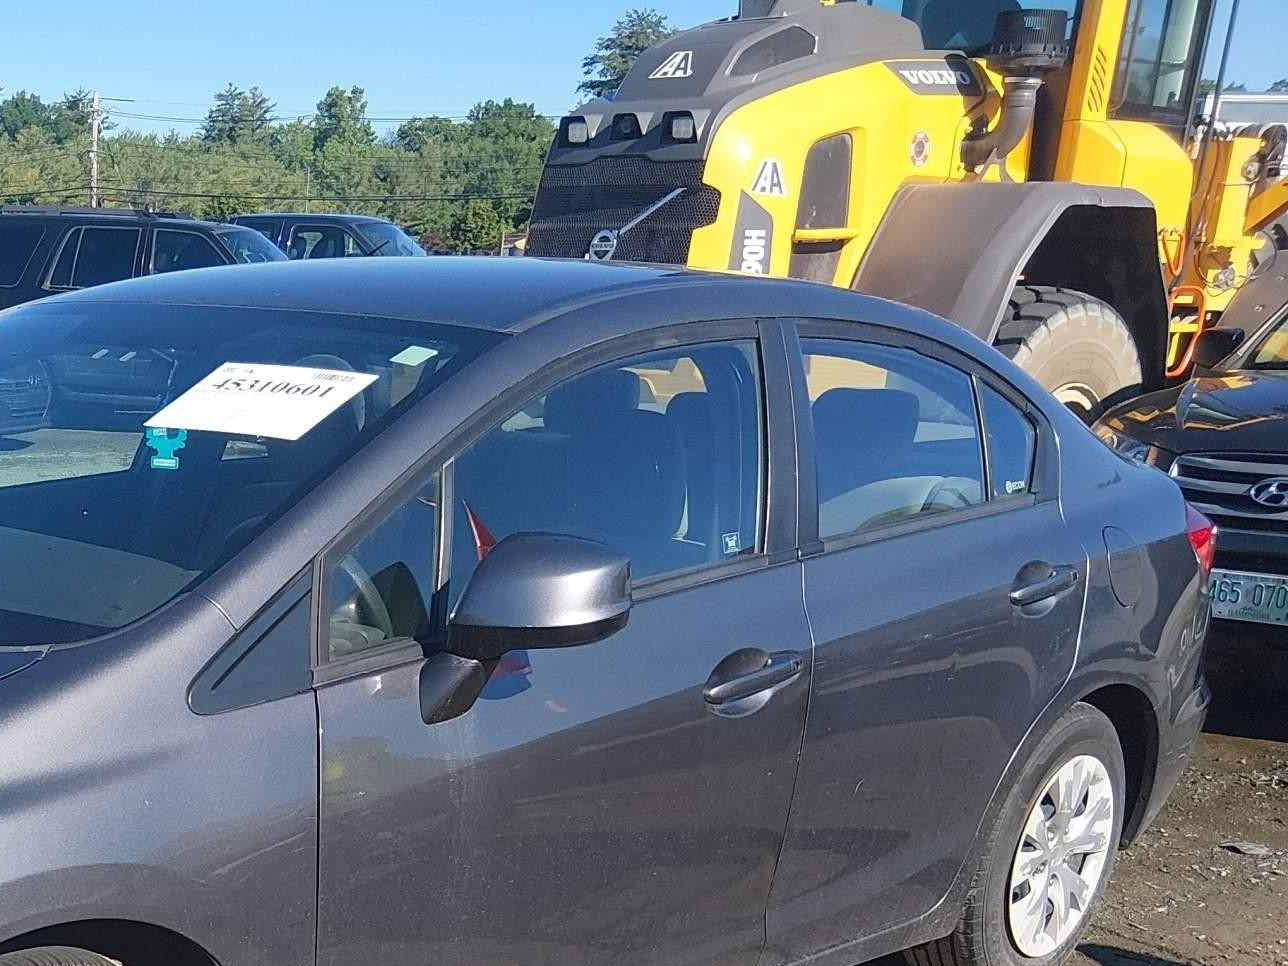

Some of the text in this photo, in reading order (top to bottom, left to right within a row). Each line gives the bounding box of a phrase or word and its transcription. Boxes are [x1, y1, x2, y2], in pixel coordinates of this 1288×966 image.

[898, 70, 971, 85] VOLVO
[212, 378, 335, 397] 45310601
[1209, 579, 1244, 604] 465
